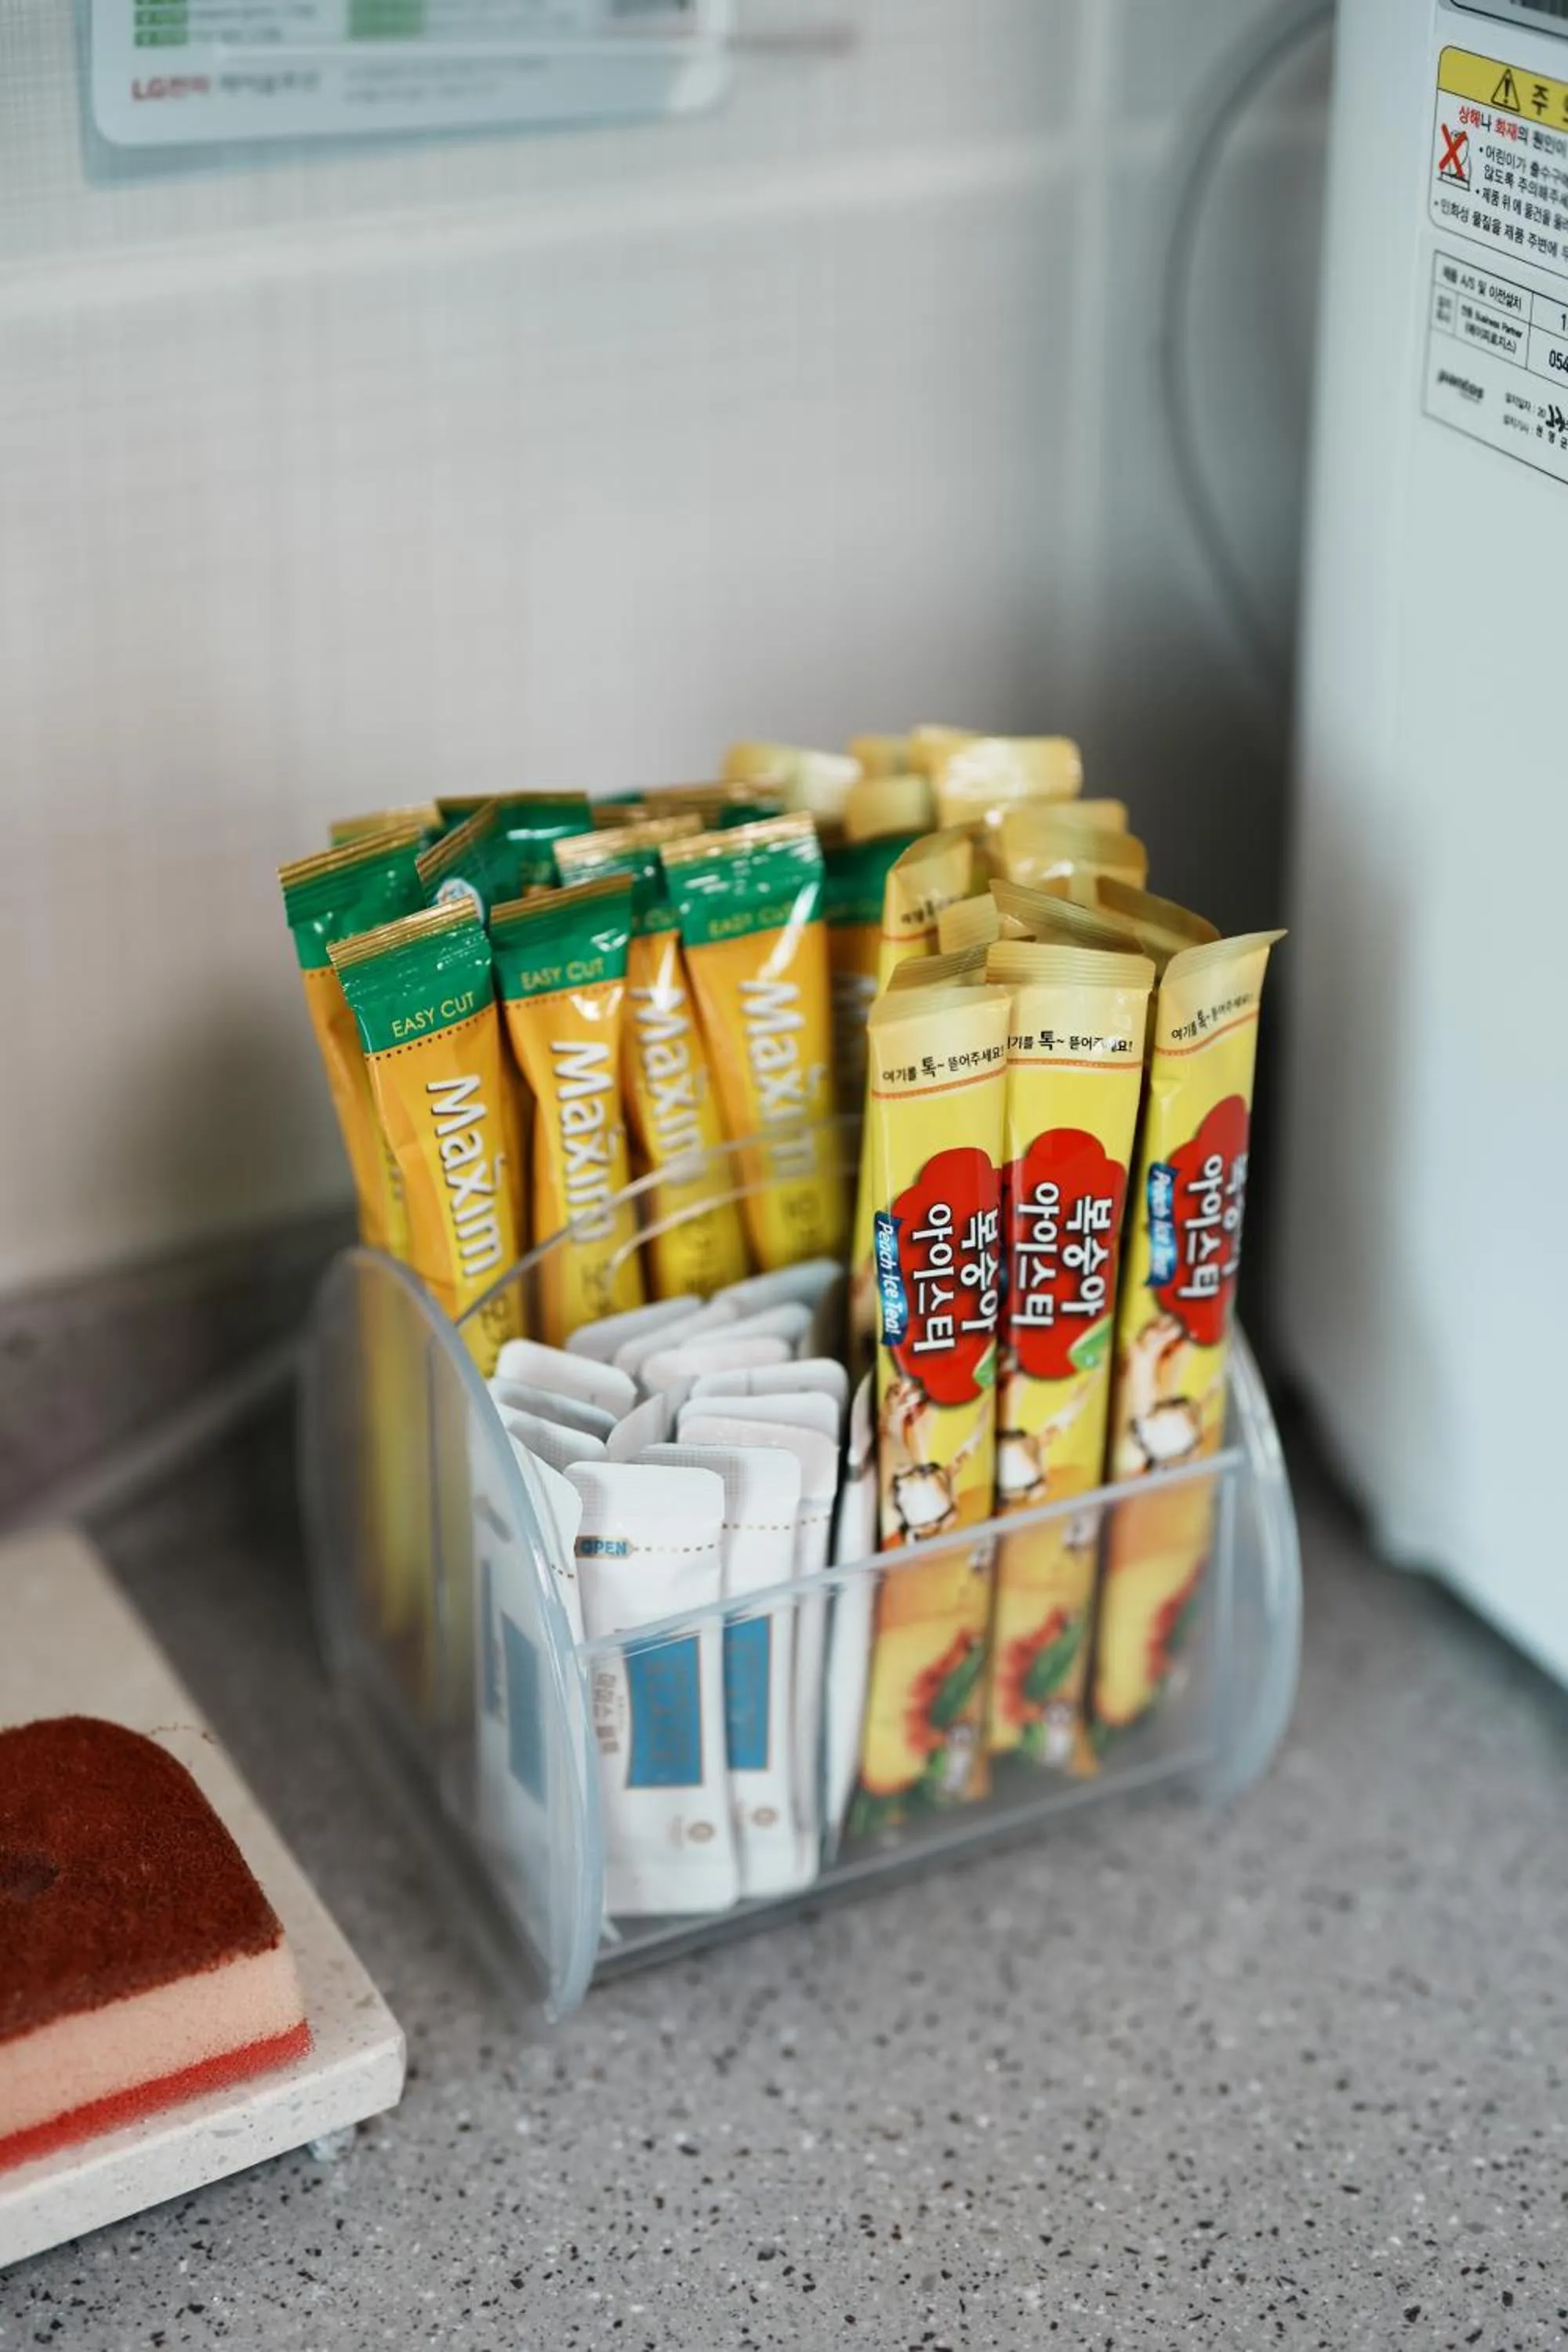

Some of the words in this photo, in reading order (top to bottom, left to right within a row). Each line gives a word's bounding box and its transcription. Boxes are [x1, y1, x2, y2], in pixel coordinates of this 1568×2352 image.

[1486, 145, 1526, 173] 어린이가
[521, 967, 562, 992] EASY
[566, 956, 604, 981] CUT
[392, 1007, 435, 1038] EASY
[441, 992, 474, 1018] CUT
[882, 1065, 917, 1083] 여기를
[551, 1040, 617, 1243] Maxim
[426, 1073, 504, 1277] Maxim
[877, 1220, 898, 1269] Peach
[1178, 1153, 1224, 1298] 아이스티
[912, 1203, 956, 1353] 아이스티
[960, 1207, 999, 1332] 복숭아
[1011, 1181, 1061, 1327] 아이스티
[1060, 1195, 1113, 1317] 복숭아
[883, 1273, 901, 1299] Ice
[884, 1301, 904, 1335] Tea!
[581, 1539, 627, 1556] OPEN
